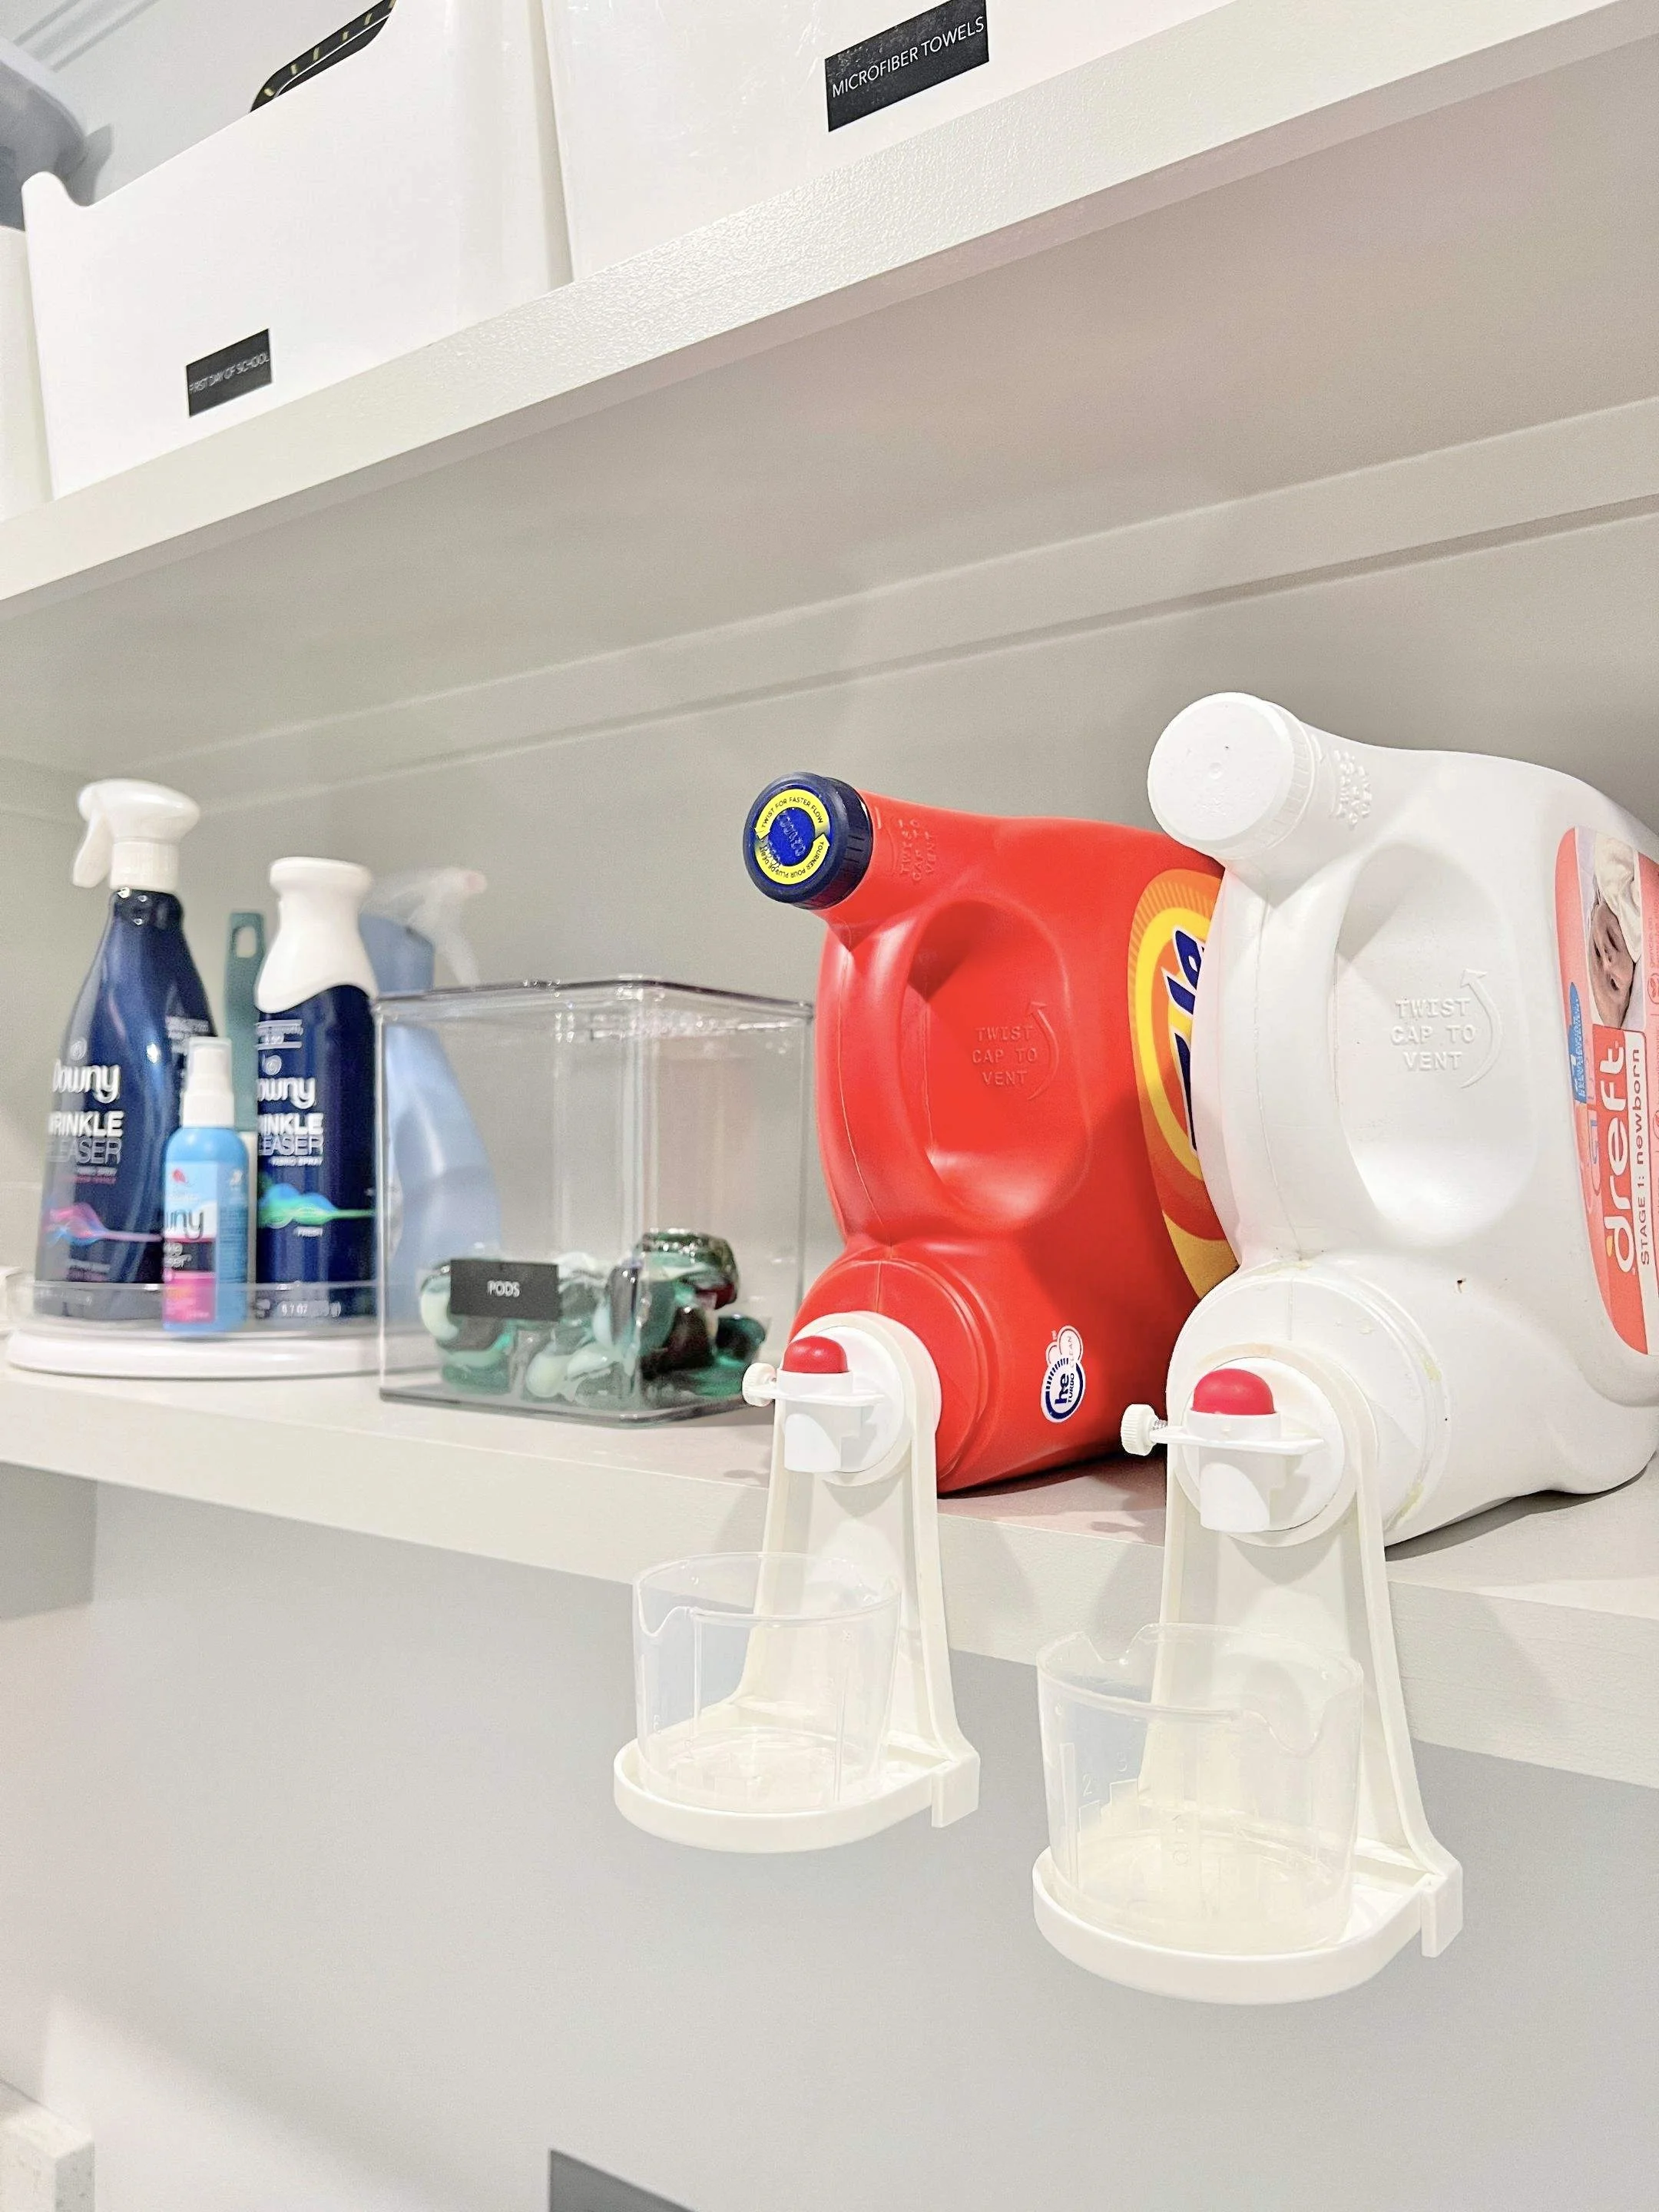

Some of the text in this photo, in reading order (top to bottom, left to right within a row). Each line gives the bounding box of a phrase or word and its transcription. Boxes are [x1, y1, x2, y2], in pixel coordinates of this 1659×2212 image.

[832, 15, 985, 98] MICROFIBER TOWELS
[236, 352, 270, 375] SCHOOL
[761, 796, 824, 829] TWIST FOR FASTER FLOW
[806, 841, 825, 870] TOURNER
[790, 868, 806, 879] POUR
[1395, 997, 1472, 1019] TWIST
[974, 1025, 1034, 1042] TWIST
[1391, 1024, 1477, 1046] CAP TO
[971, 1047, 1038, 1065] CAP TO
[1402, 1051, 1463, 1071] VENT
[981, 1069, 1028, 1087] VENT
[1600, 1047, 1635, 1273] dreft
[1631, 1048, 1651, 1267] STAGE 1: newborn
[487, 1280, 520, 1298] PODS
[1066, 1335, 1075, 1403] TURBO CLEAN
[1054, 1373, 1070, 1405] he
